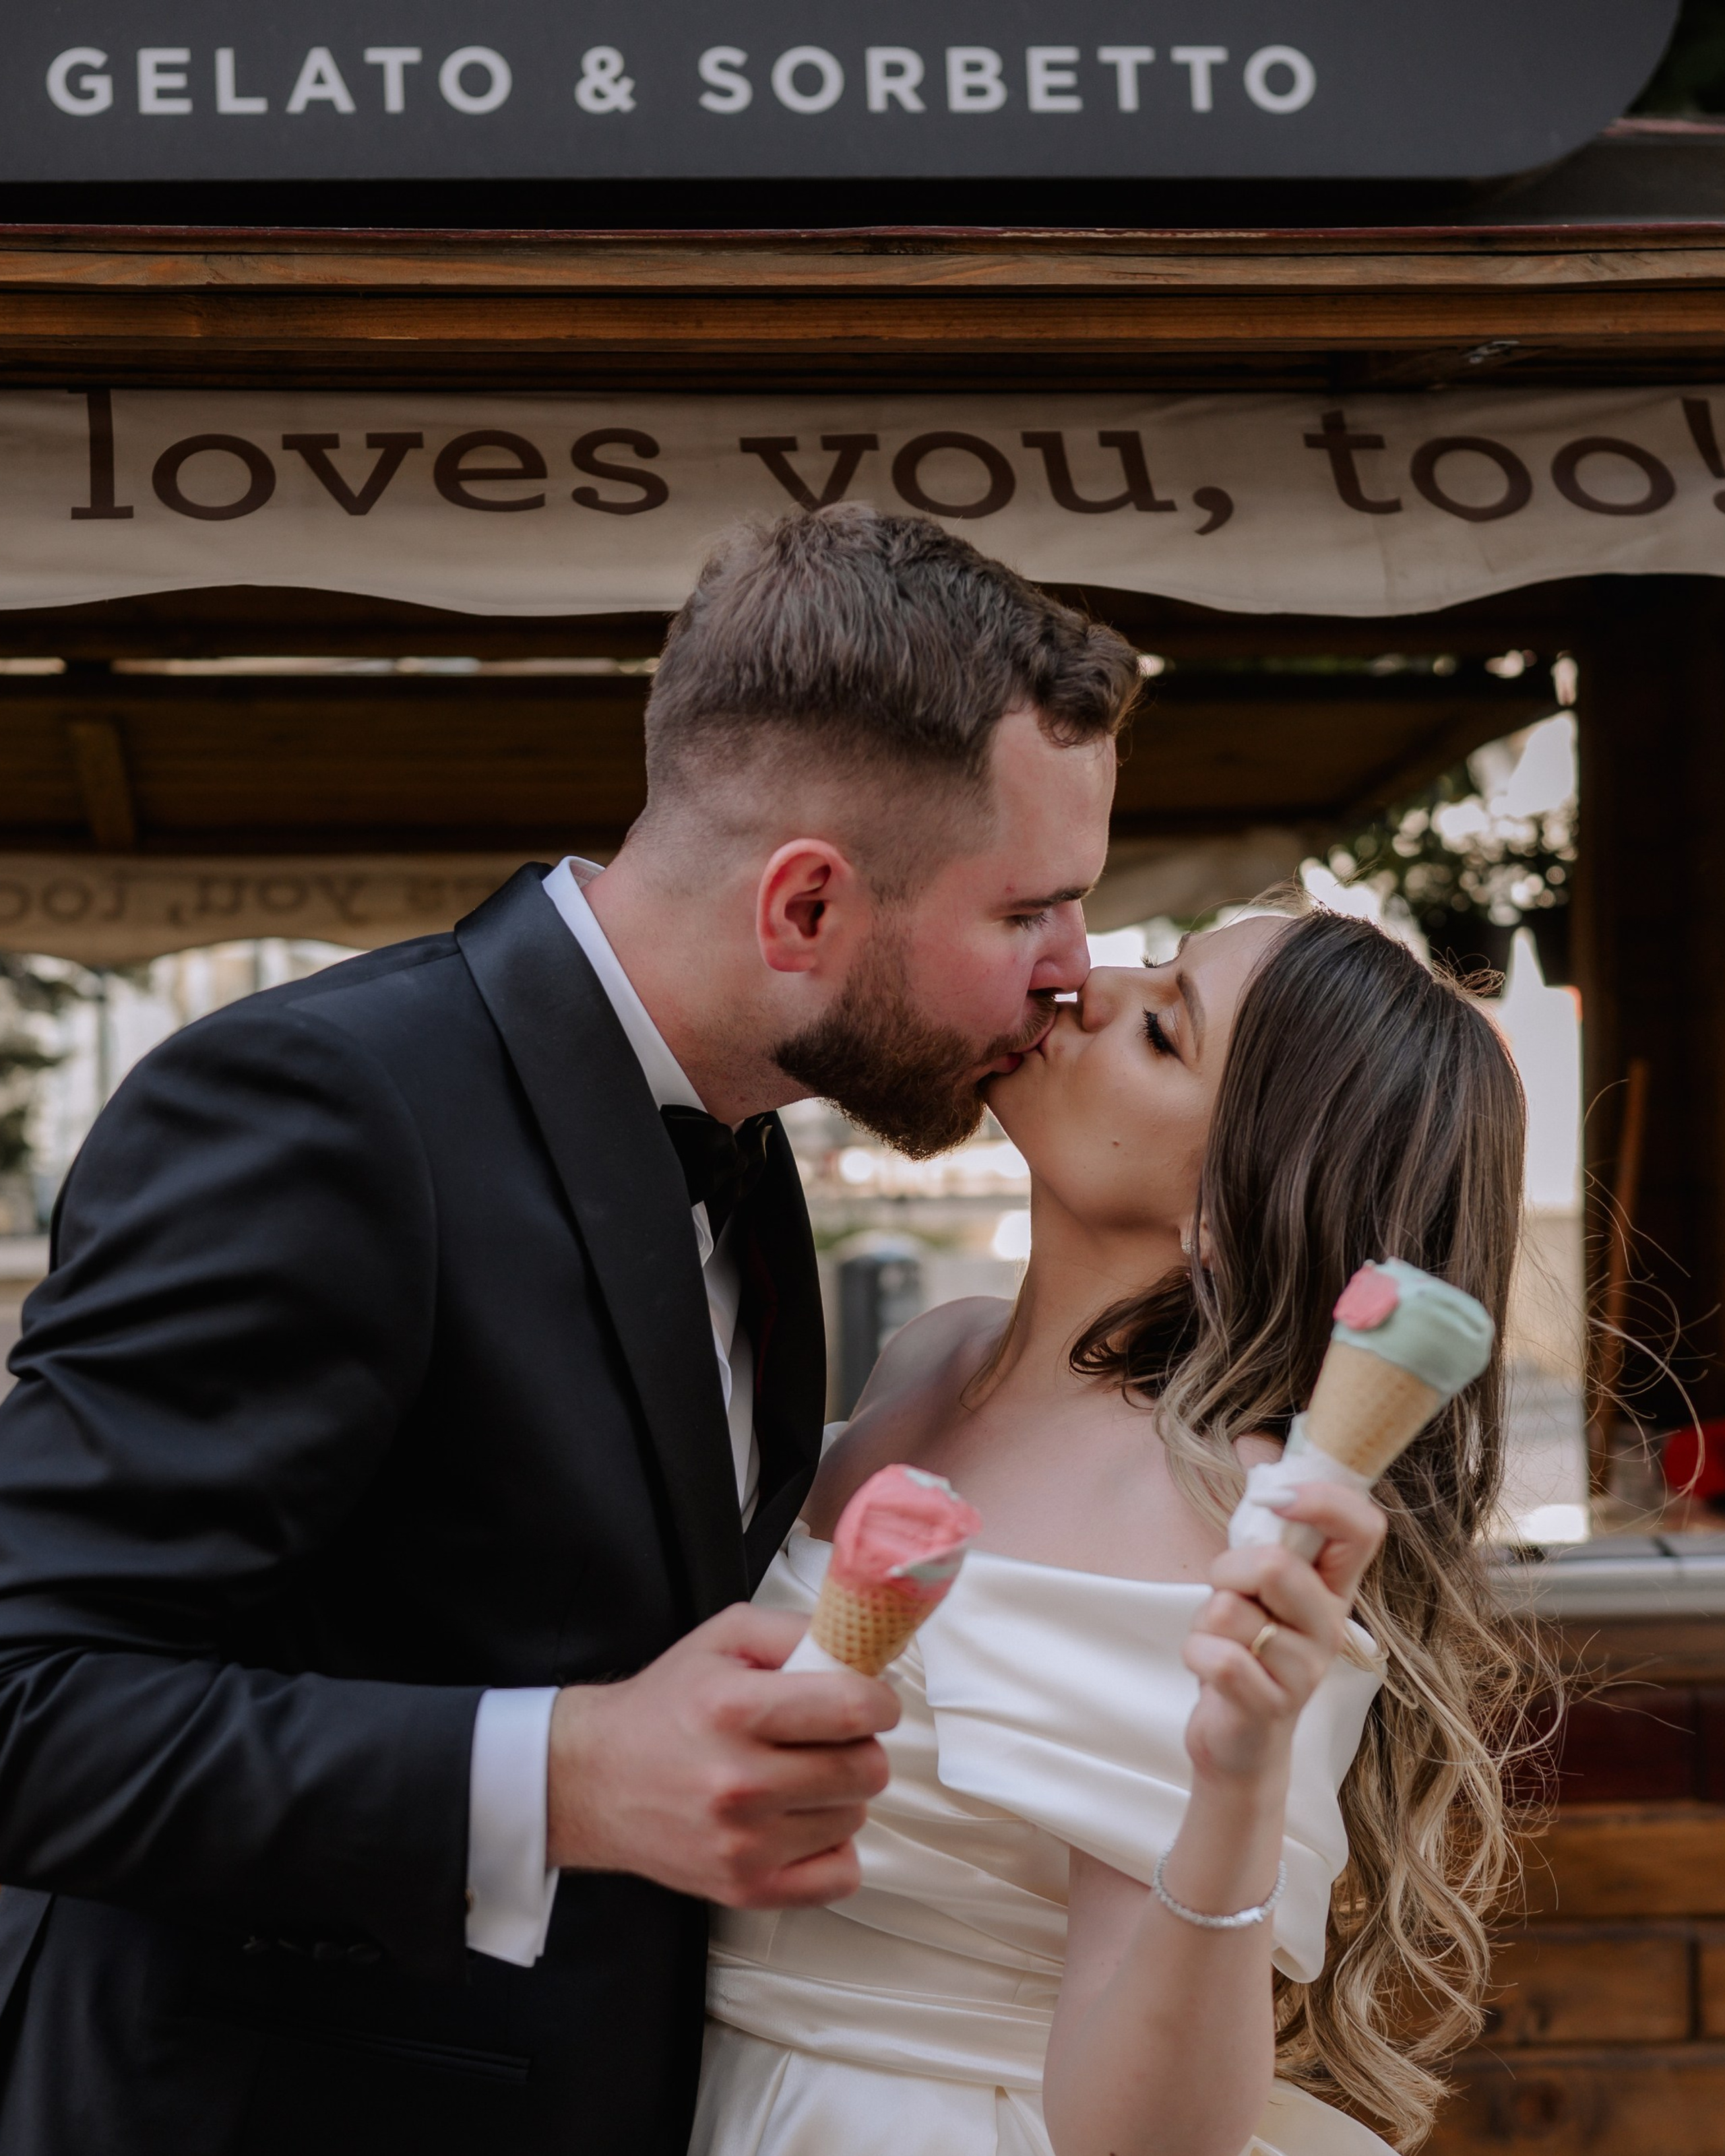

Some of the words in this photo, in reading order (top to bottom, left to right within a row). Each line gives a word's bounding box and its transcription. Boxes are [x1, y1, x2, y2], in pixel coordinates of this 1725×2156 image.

[46, 45, 513, 116] GELATO
[574, 45, 637, 115] &
[697, 45, 1317, 114] SORBETTO
[67, 387, 669, 521] loves
[1303, 398, 1725, 523] too!
